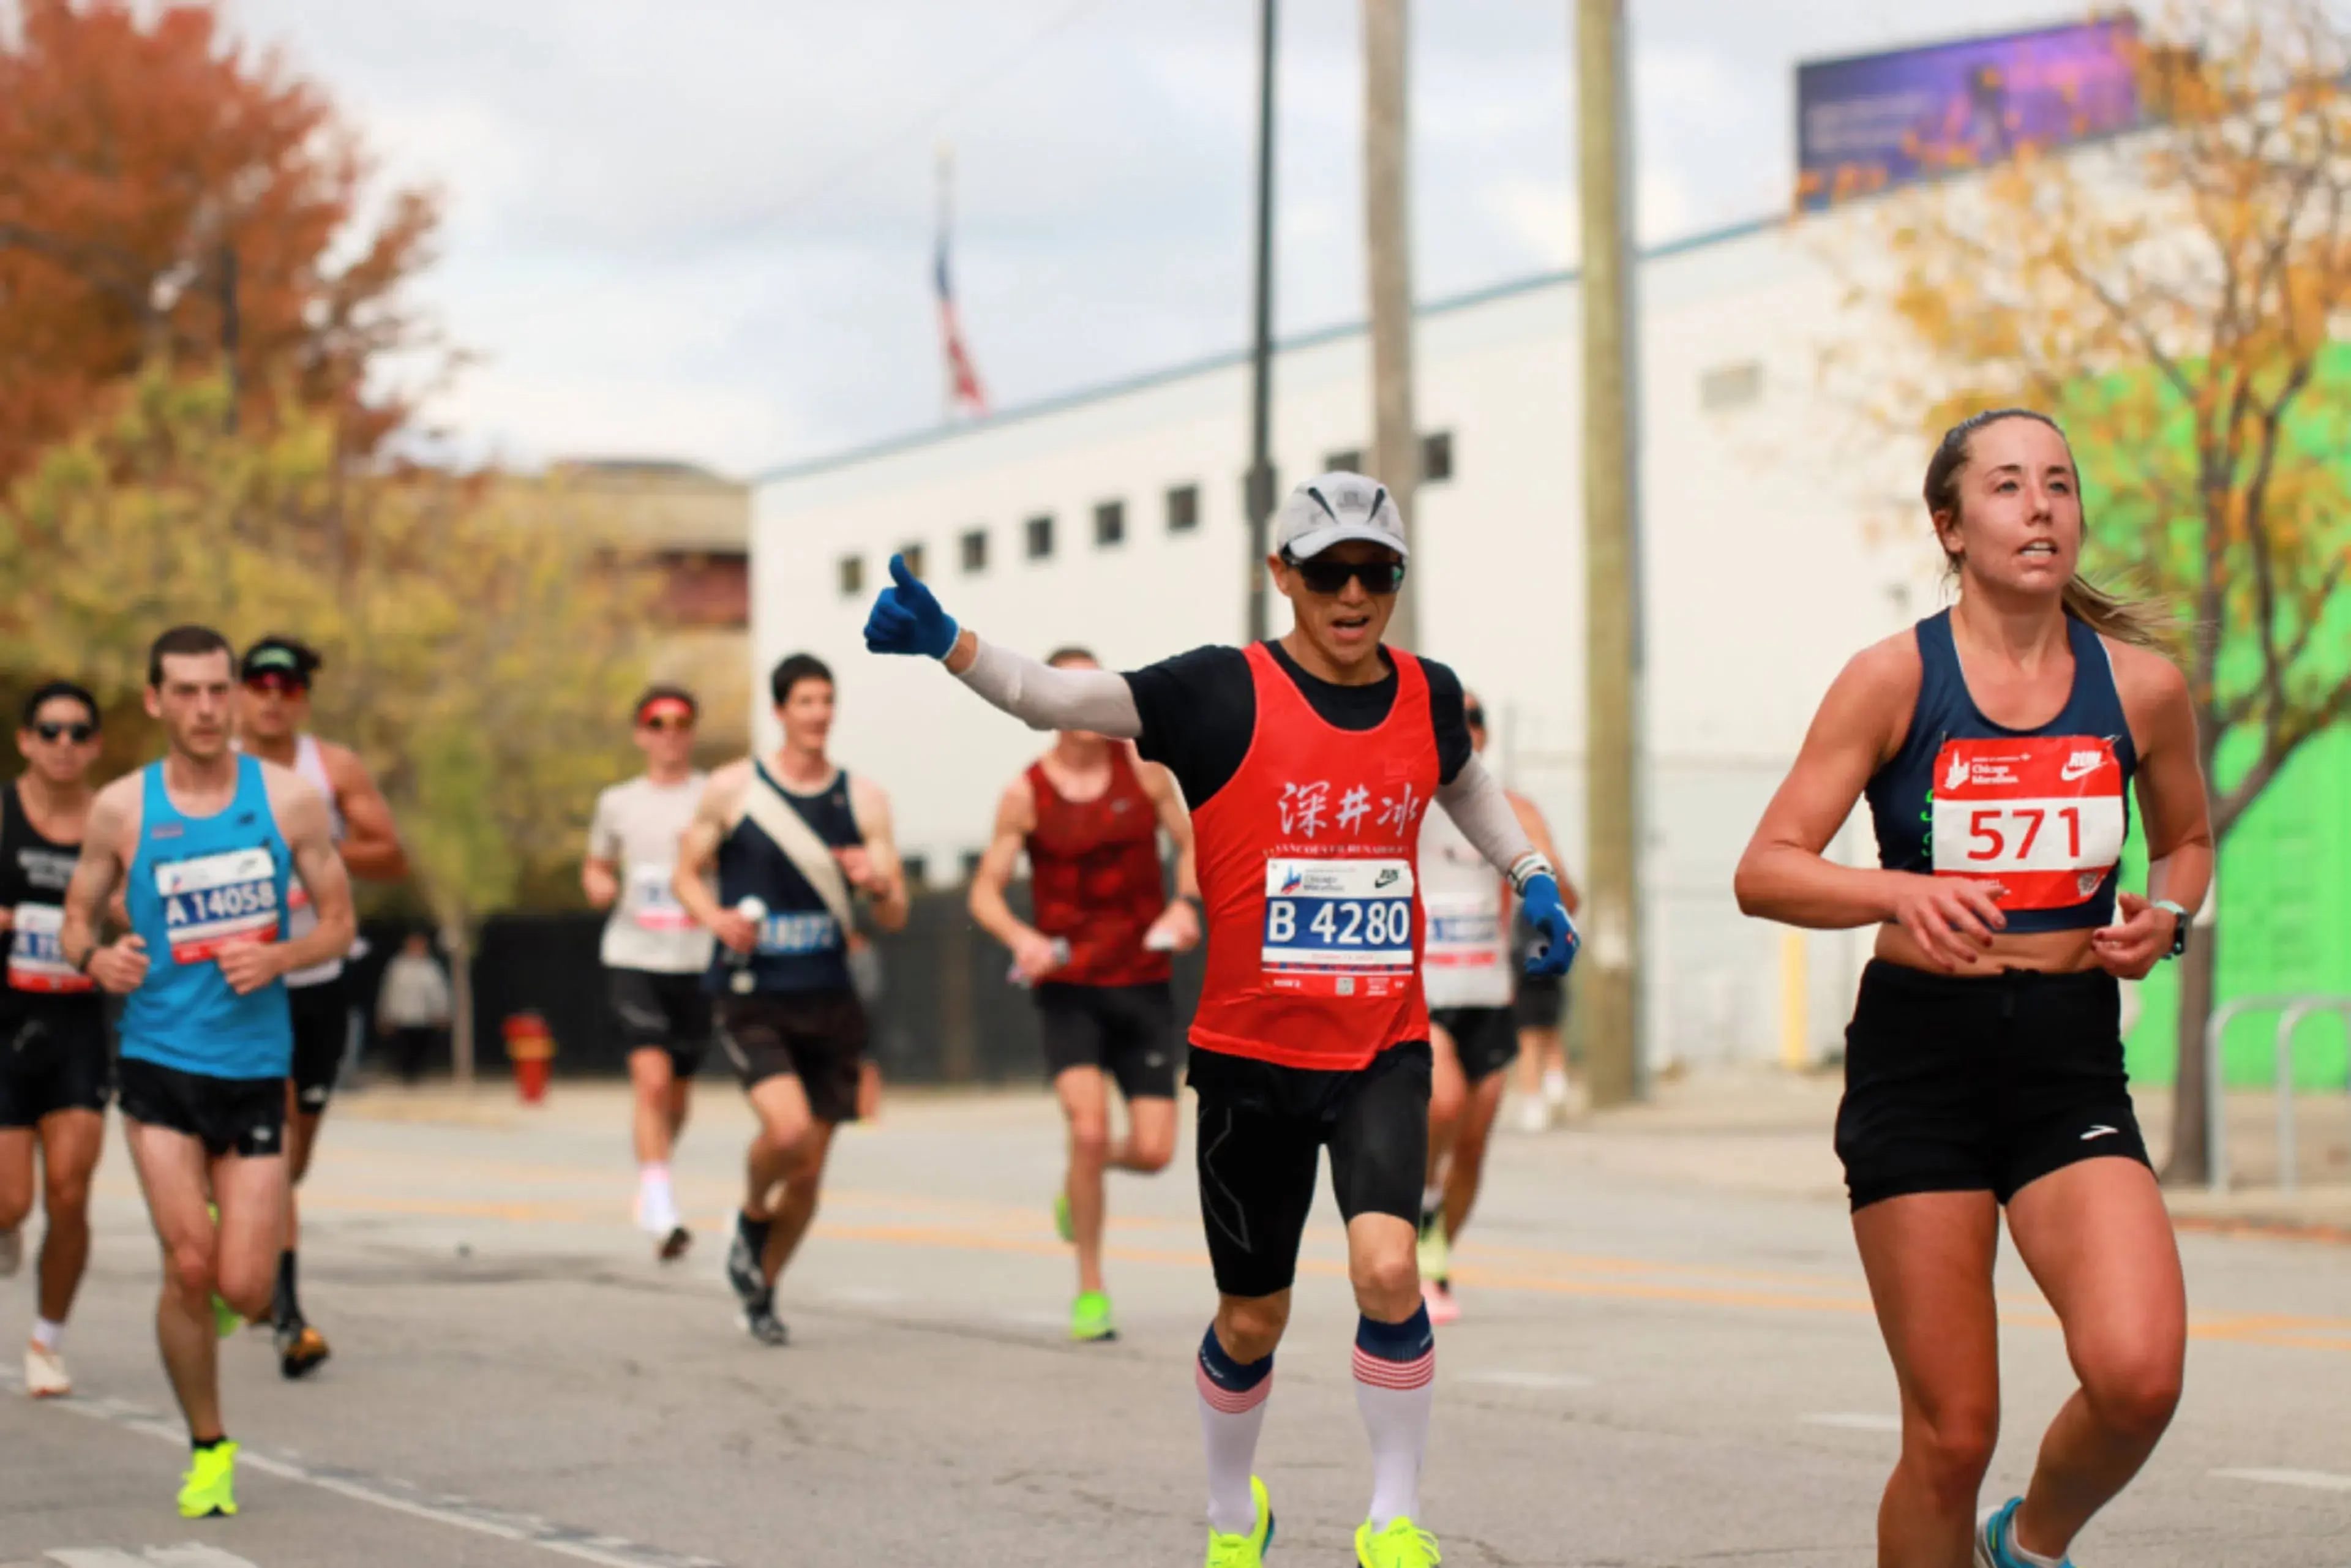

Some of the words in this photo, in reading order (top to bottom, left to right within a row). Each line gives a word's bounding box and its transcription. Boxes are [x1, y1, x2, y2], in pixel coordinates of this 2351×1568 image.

[1967, 806, 2080, 861] 571
[167, 895, 188, 925] A
[190, 880, 276, 921] 14058
[1269, 901, 1295, 942] B
[1310, 901, 1409, 945] 4280
